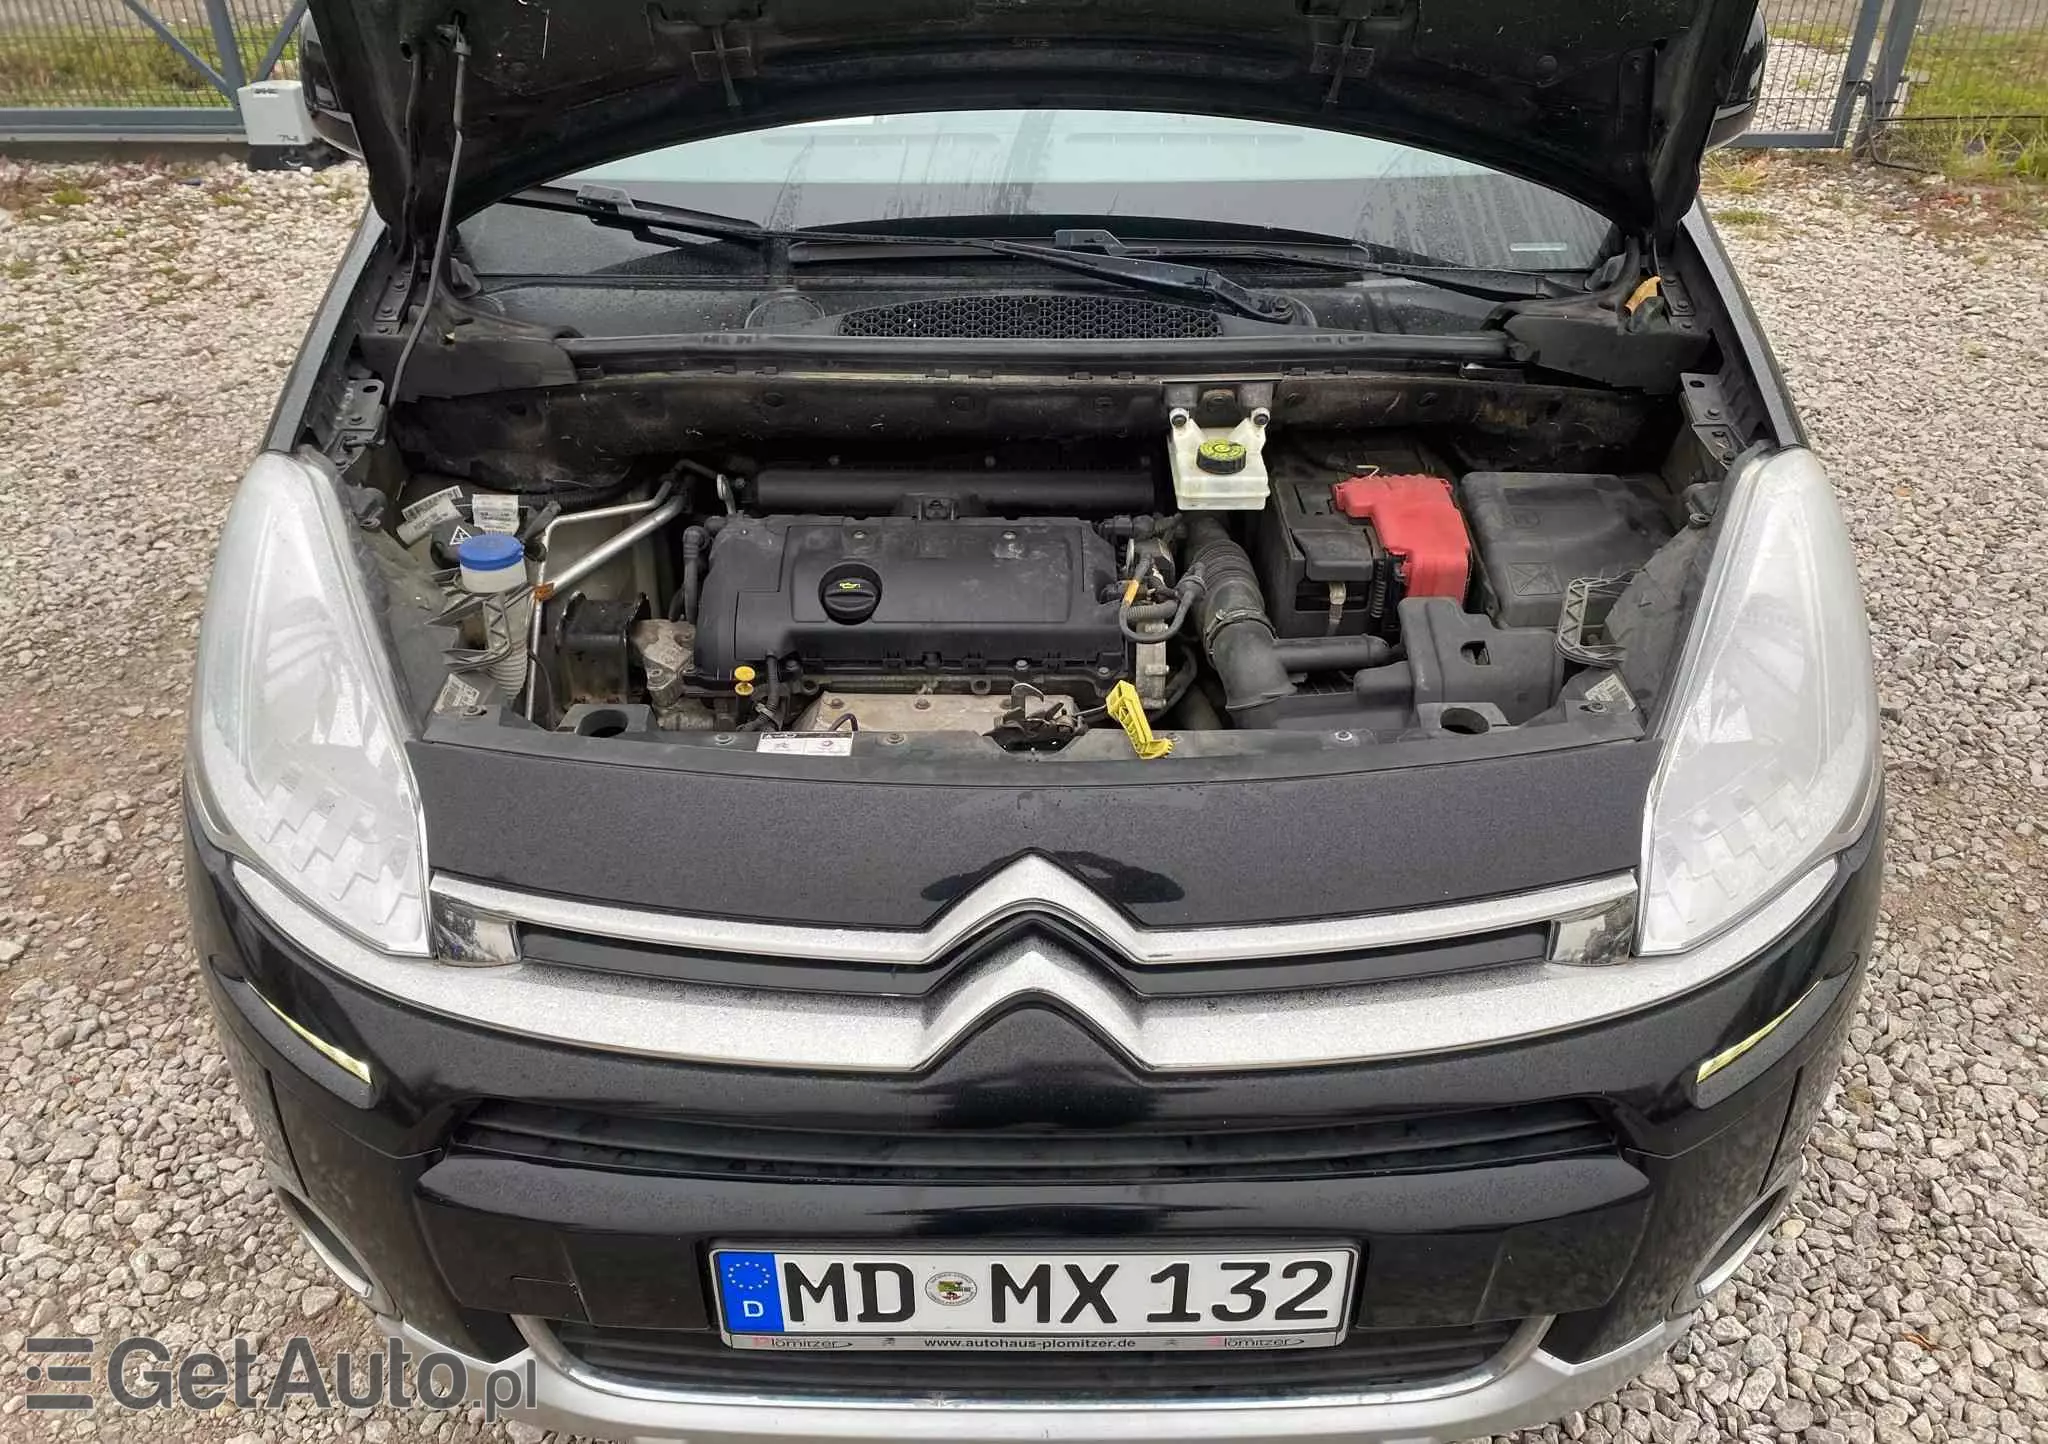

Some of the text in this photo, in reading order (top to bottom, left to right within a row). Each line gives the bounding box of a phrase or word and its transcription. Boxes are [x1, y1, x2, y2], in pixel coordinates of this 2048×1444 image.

[784, 1262, 916, 1323] MD
[990, 1263, 1120, 1323] MX
[1146, 1260, 1333, 1322] 132
[742, 1300, 764, 1318] D
[924, 1337, 1136, 1349] www.autohaus-plomitzer.de
